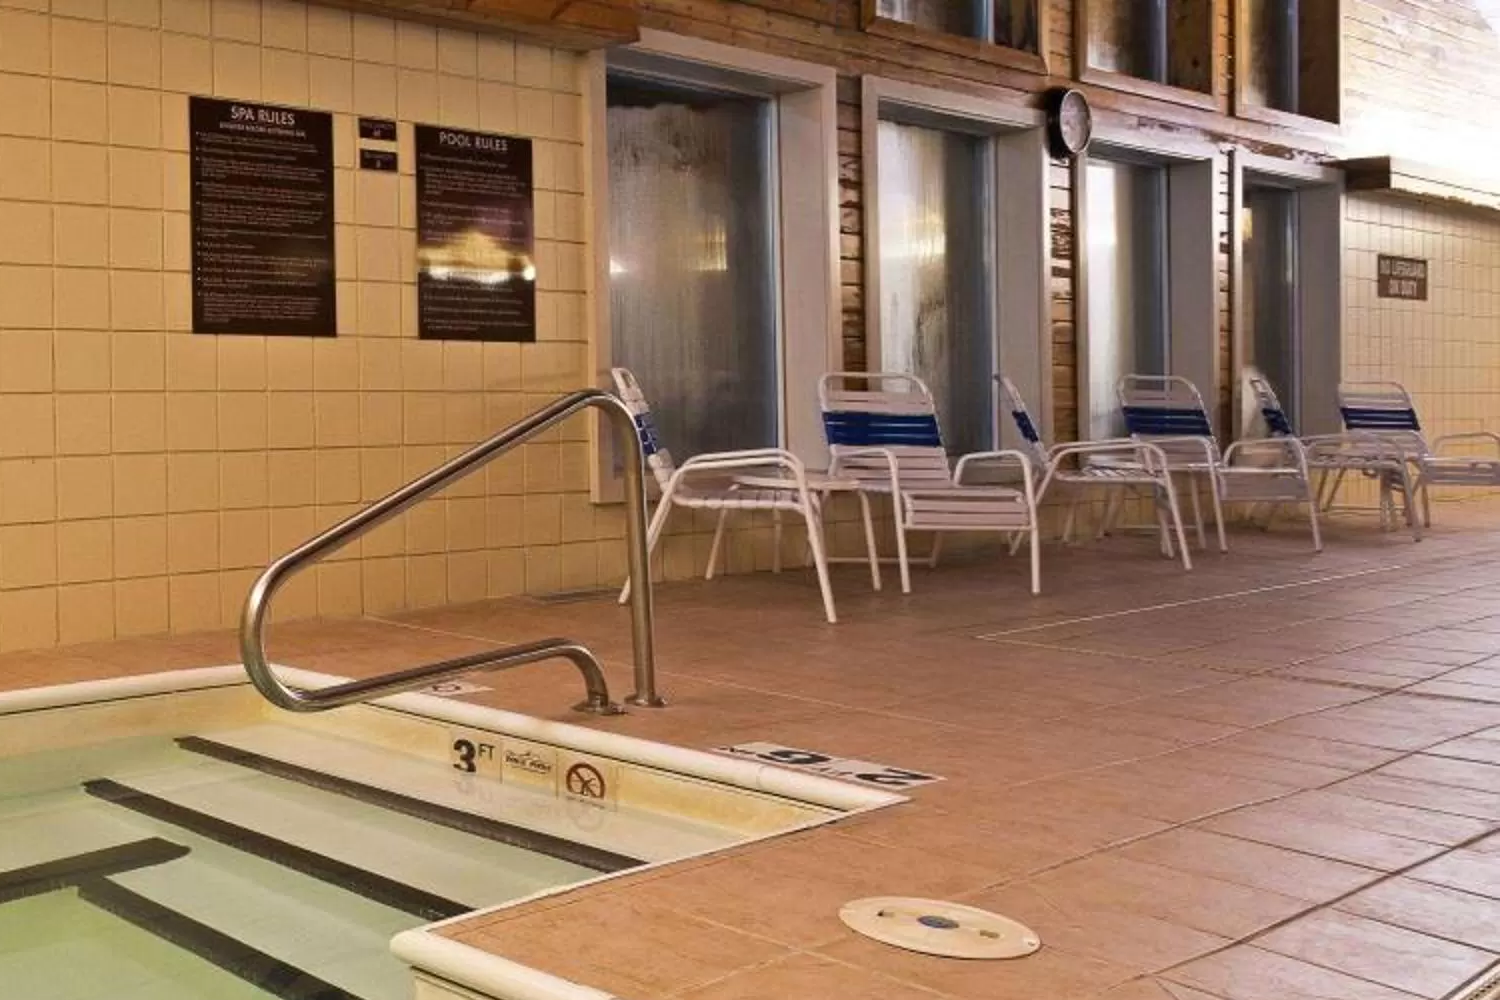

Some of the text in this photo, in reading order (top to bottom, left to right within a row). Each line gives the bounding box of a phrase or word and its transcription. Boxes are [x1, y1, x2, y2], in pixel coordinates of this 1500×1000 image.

[231, 105, 295, 126] SPA RULES
[439, 131, 508, 152] POOL RULES
[453, 739, 477, 773] 3
[477, 742, 496, 761] FT
